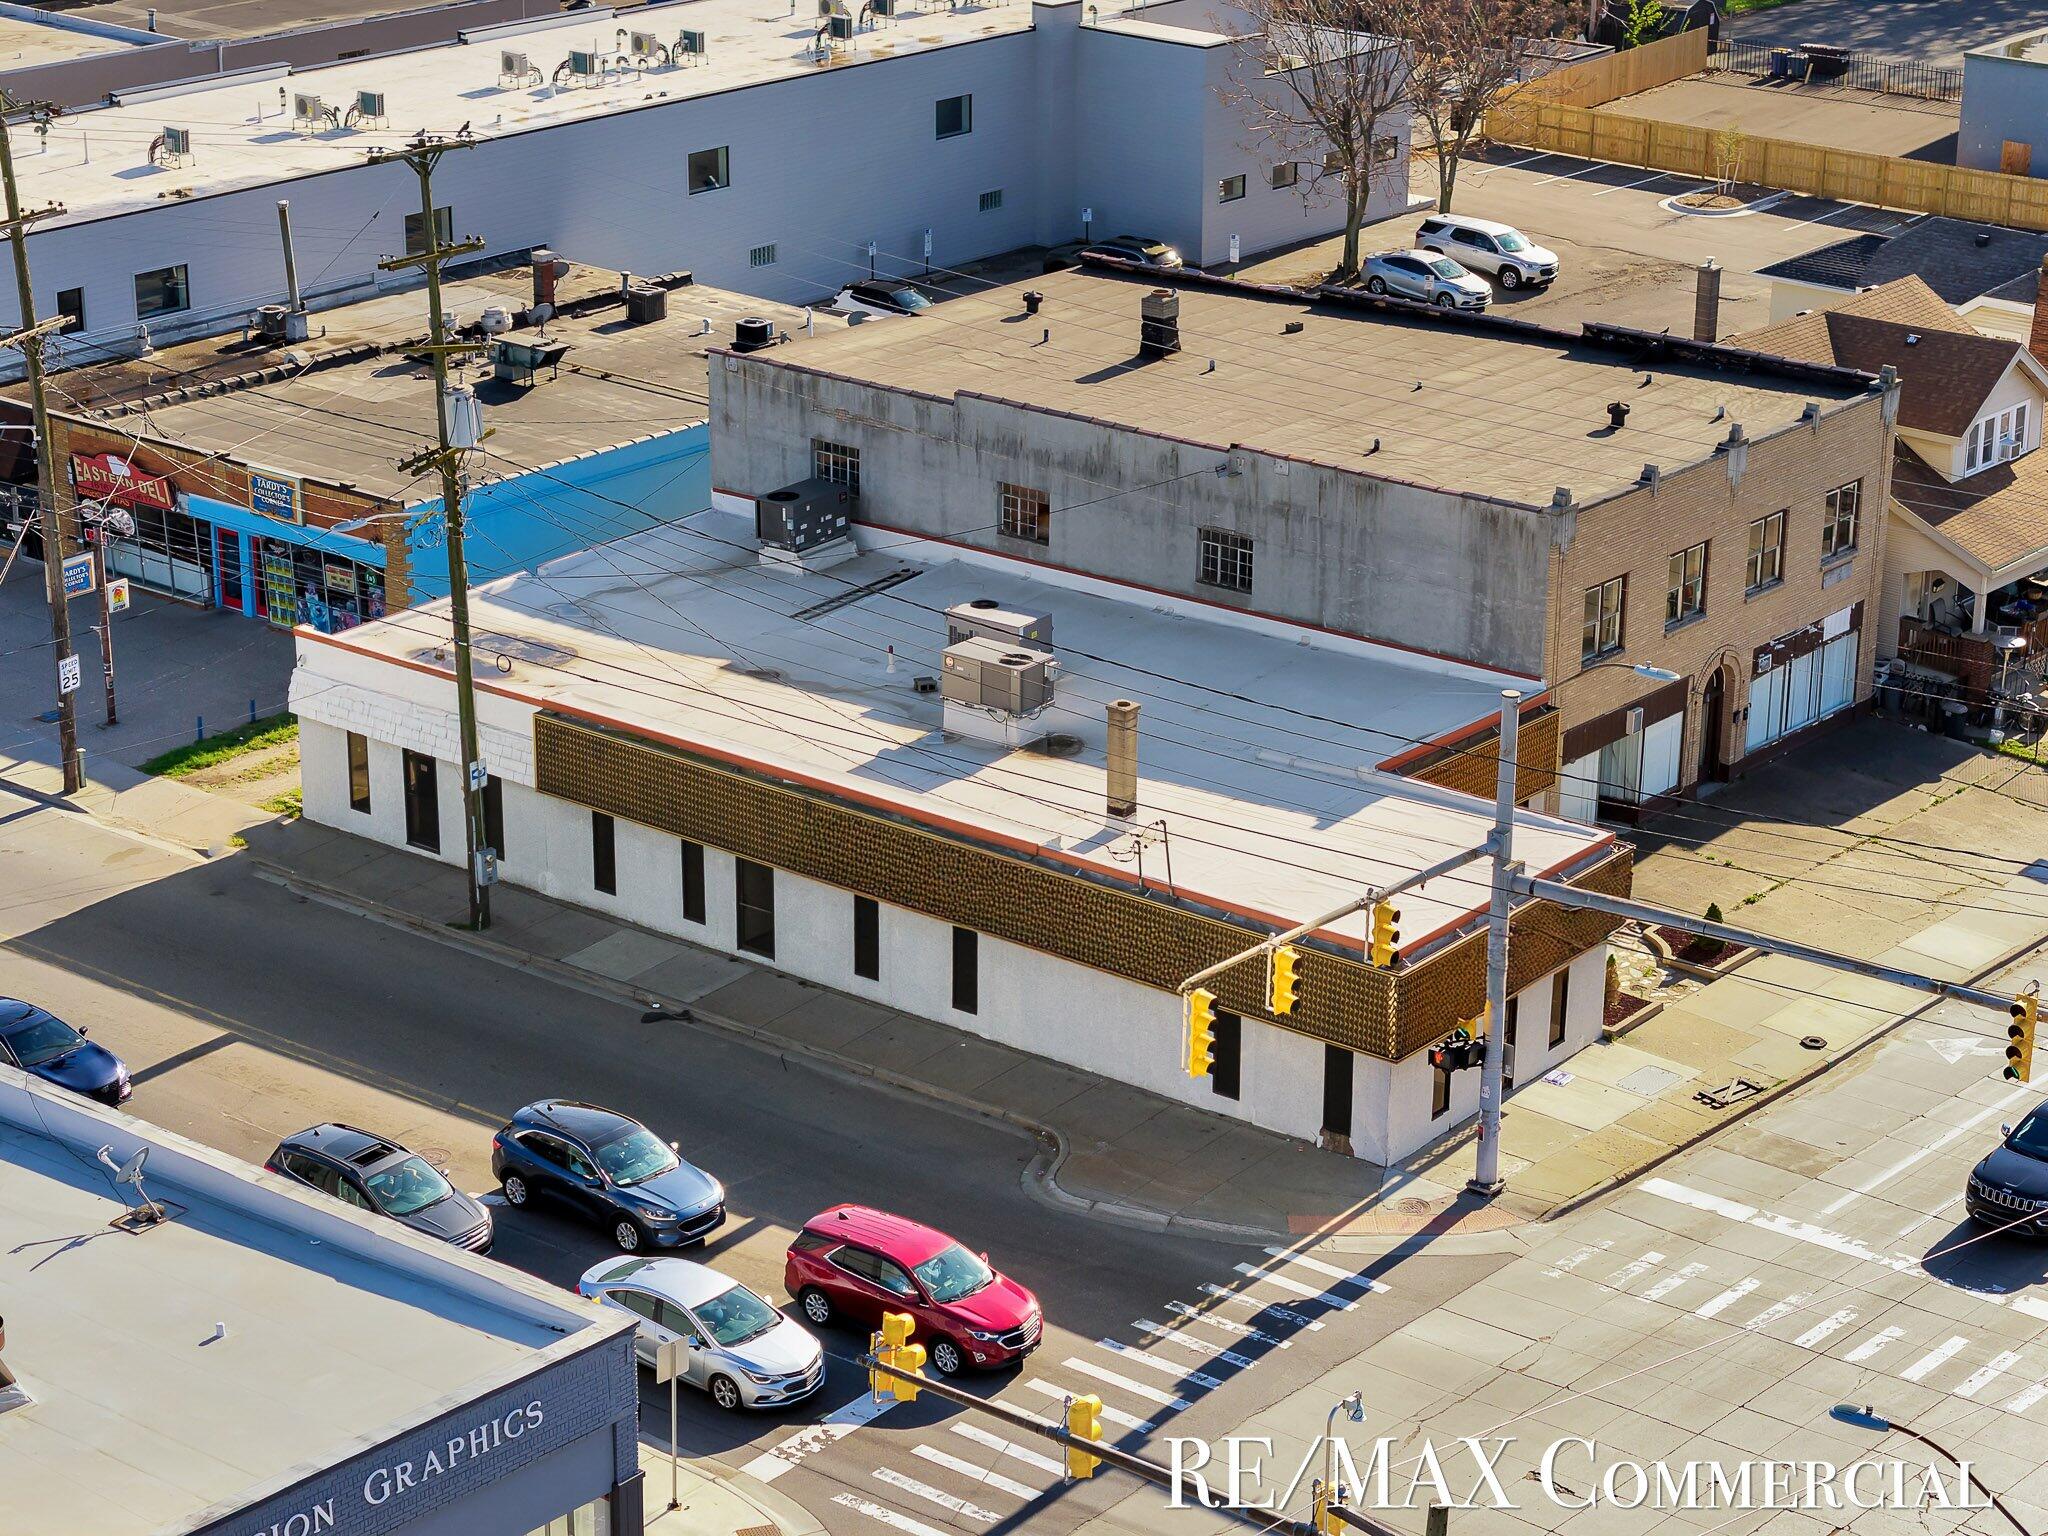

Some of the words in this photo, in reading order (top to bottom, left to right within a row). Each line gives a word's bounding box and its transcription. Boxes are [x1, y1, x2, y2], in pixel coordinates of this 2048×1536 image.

[73, 455, 134, 488] EASTERN
[138, 480, 171, 507] DELI
[256, 478, 287, 494] TARDY'S
[64, 565, 86, 577] ARDY'S
[61, 659, 78, 671] SPEED
[62, 672, 79, 690] 25
[363, 1400, 544, 1506] GRAPHICS
